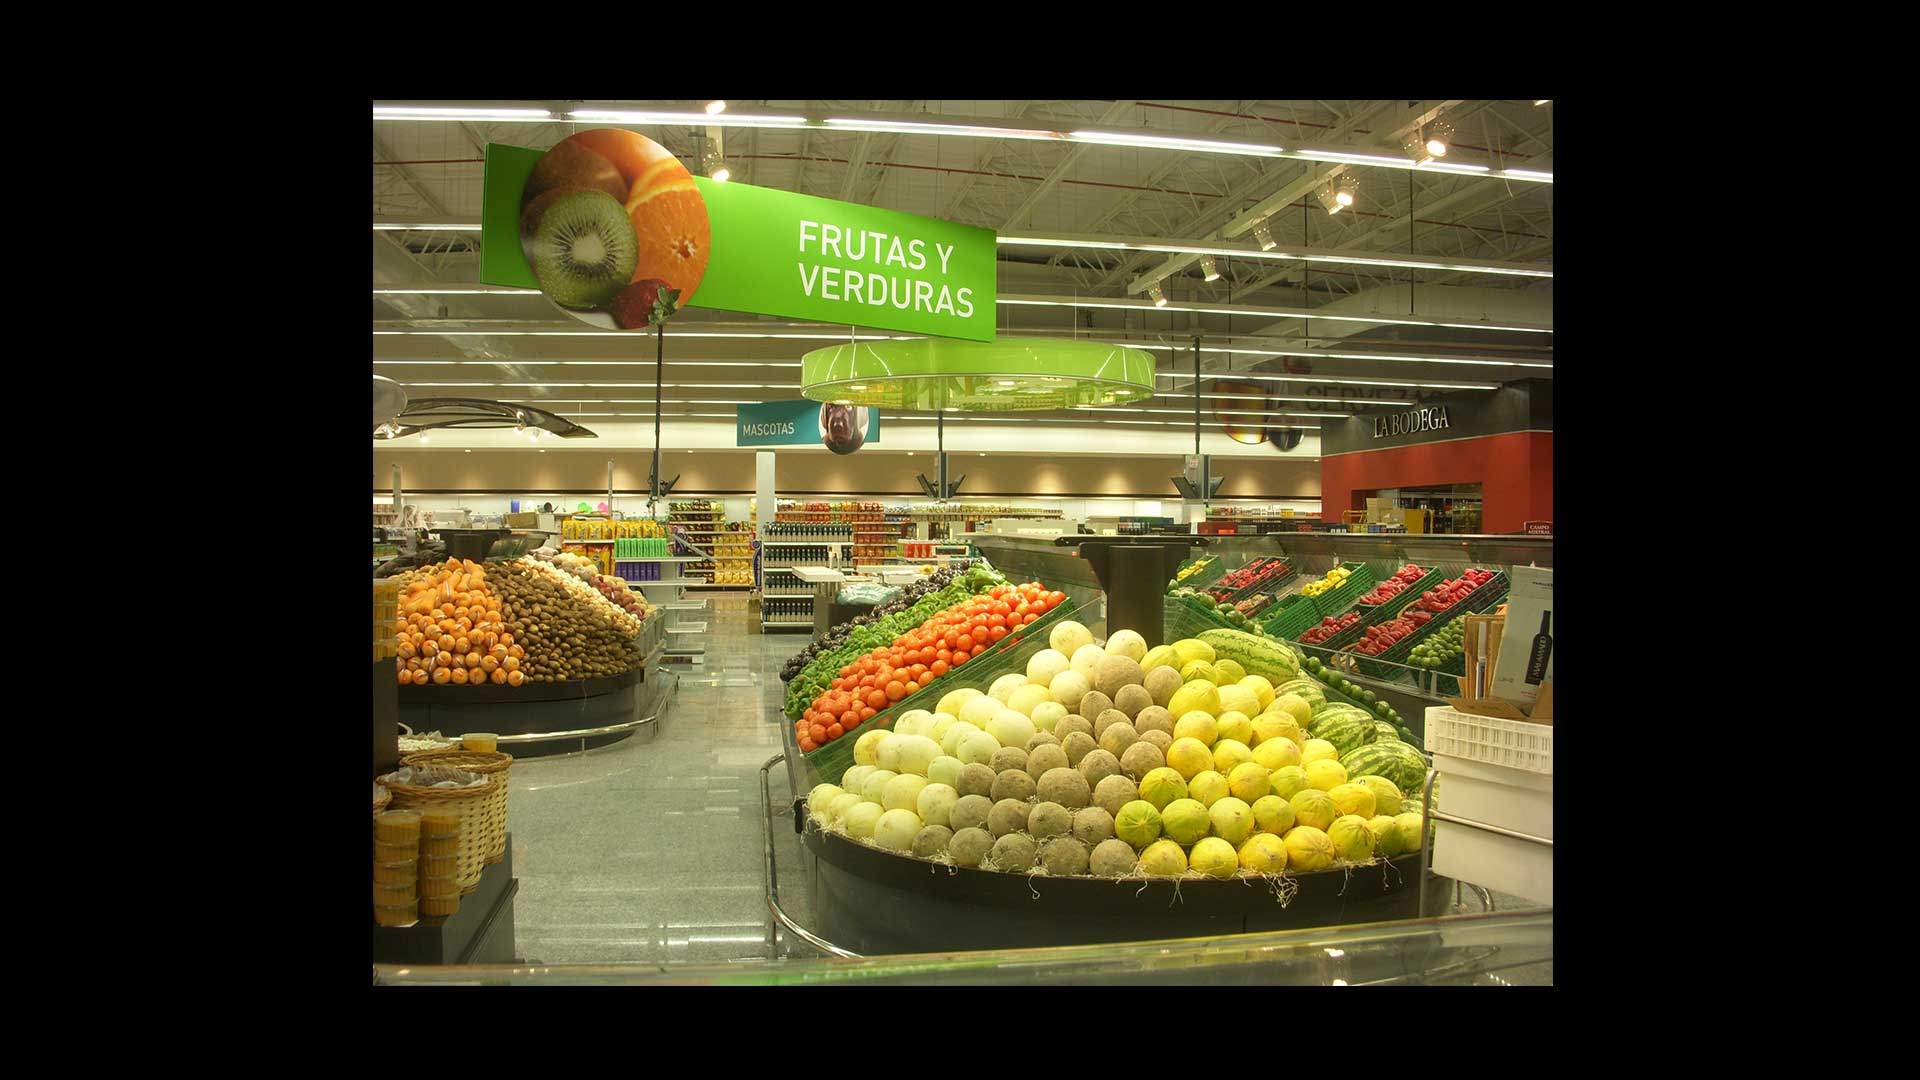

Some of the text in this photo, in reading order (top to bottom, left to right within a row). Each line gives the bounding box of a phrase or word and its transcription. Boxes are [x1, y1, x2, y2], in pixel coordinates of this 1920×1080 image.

[799, 219, 954, 275] FRUTAS Y
[798, 262, 975, 318] VERDURAS
[743, 422, 795, 436] MASCOTAS
[1373, 405, 1449, 439] LA BODEGA
